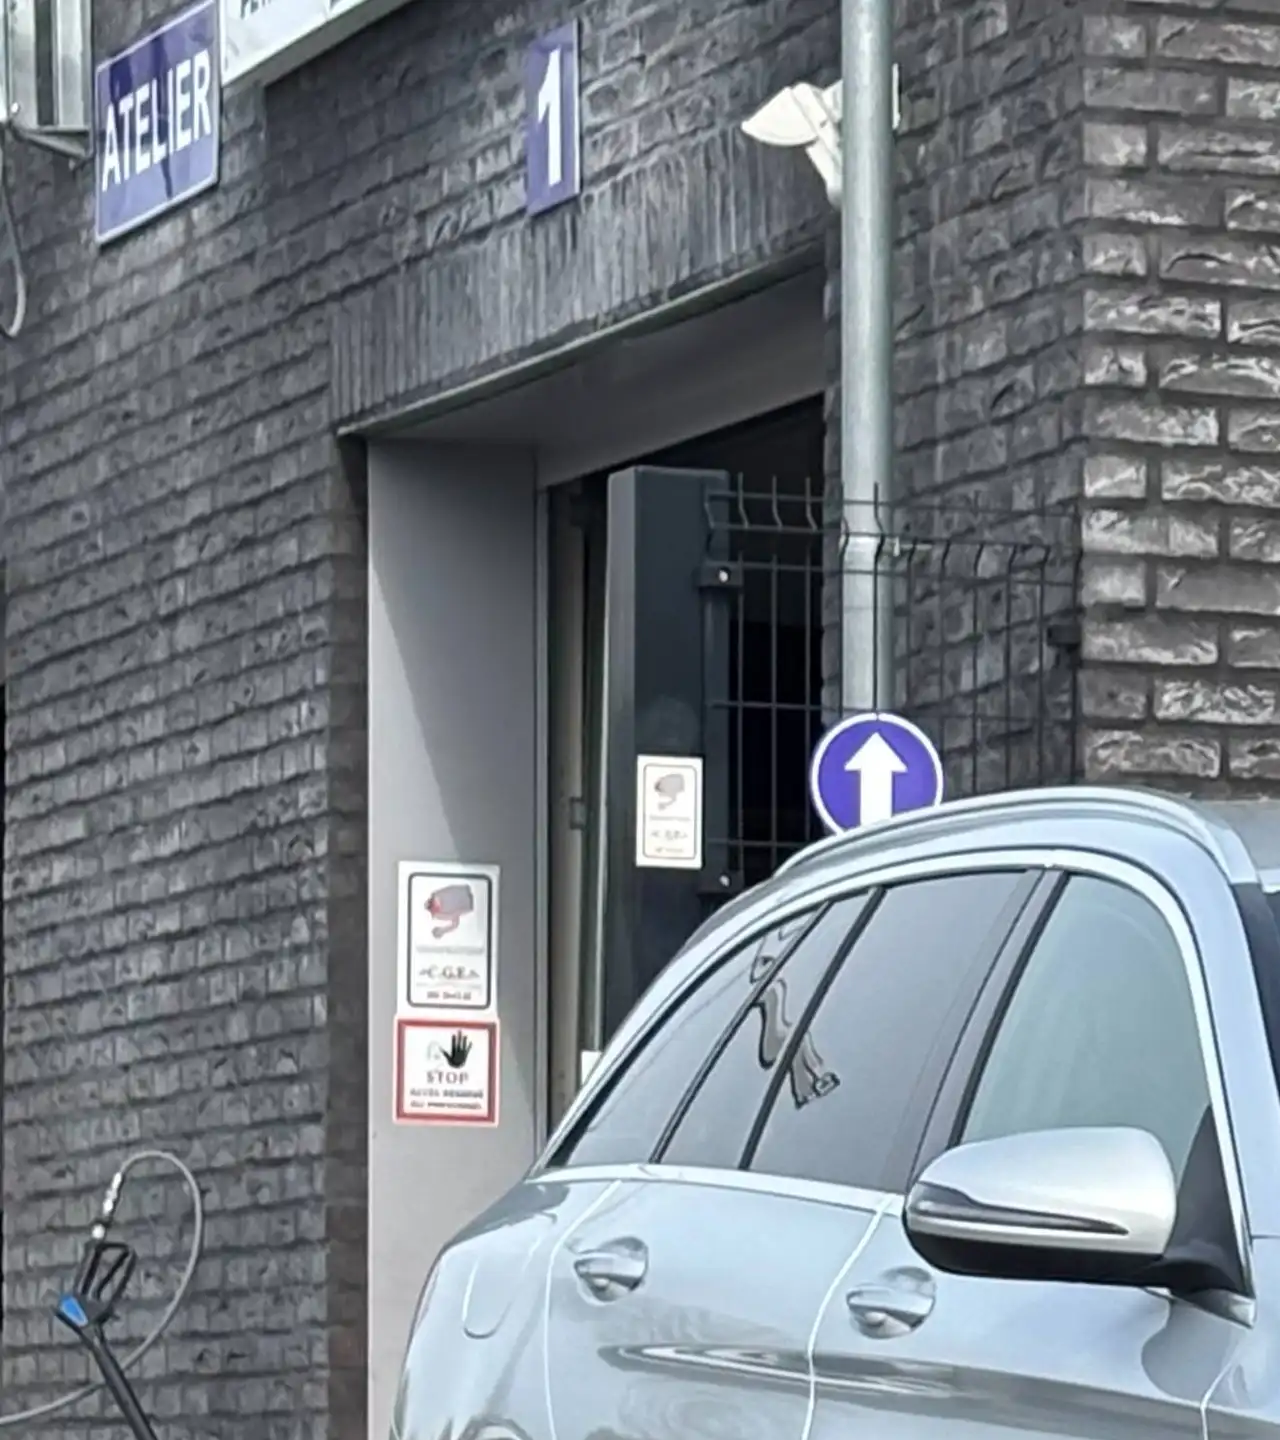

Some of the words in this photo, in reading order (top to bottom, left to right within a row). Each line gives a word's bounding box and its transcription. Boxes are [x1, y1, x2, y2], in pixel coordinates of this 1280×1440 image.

[100, 49, 213, 193] ATELIER
[537, 48, 563, 188] 1
[426, 1069, 469, 1085] STOP
